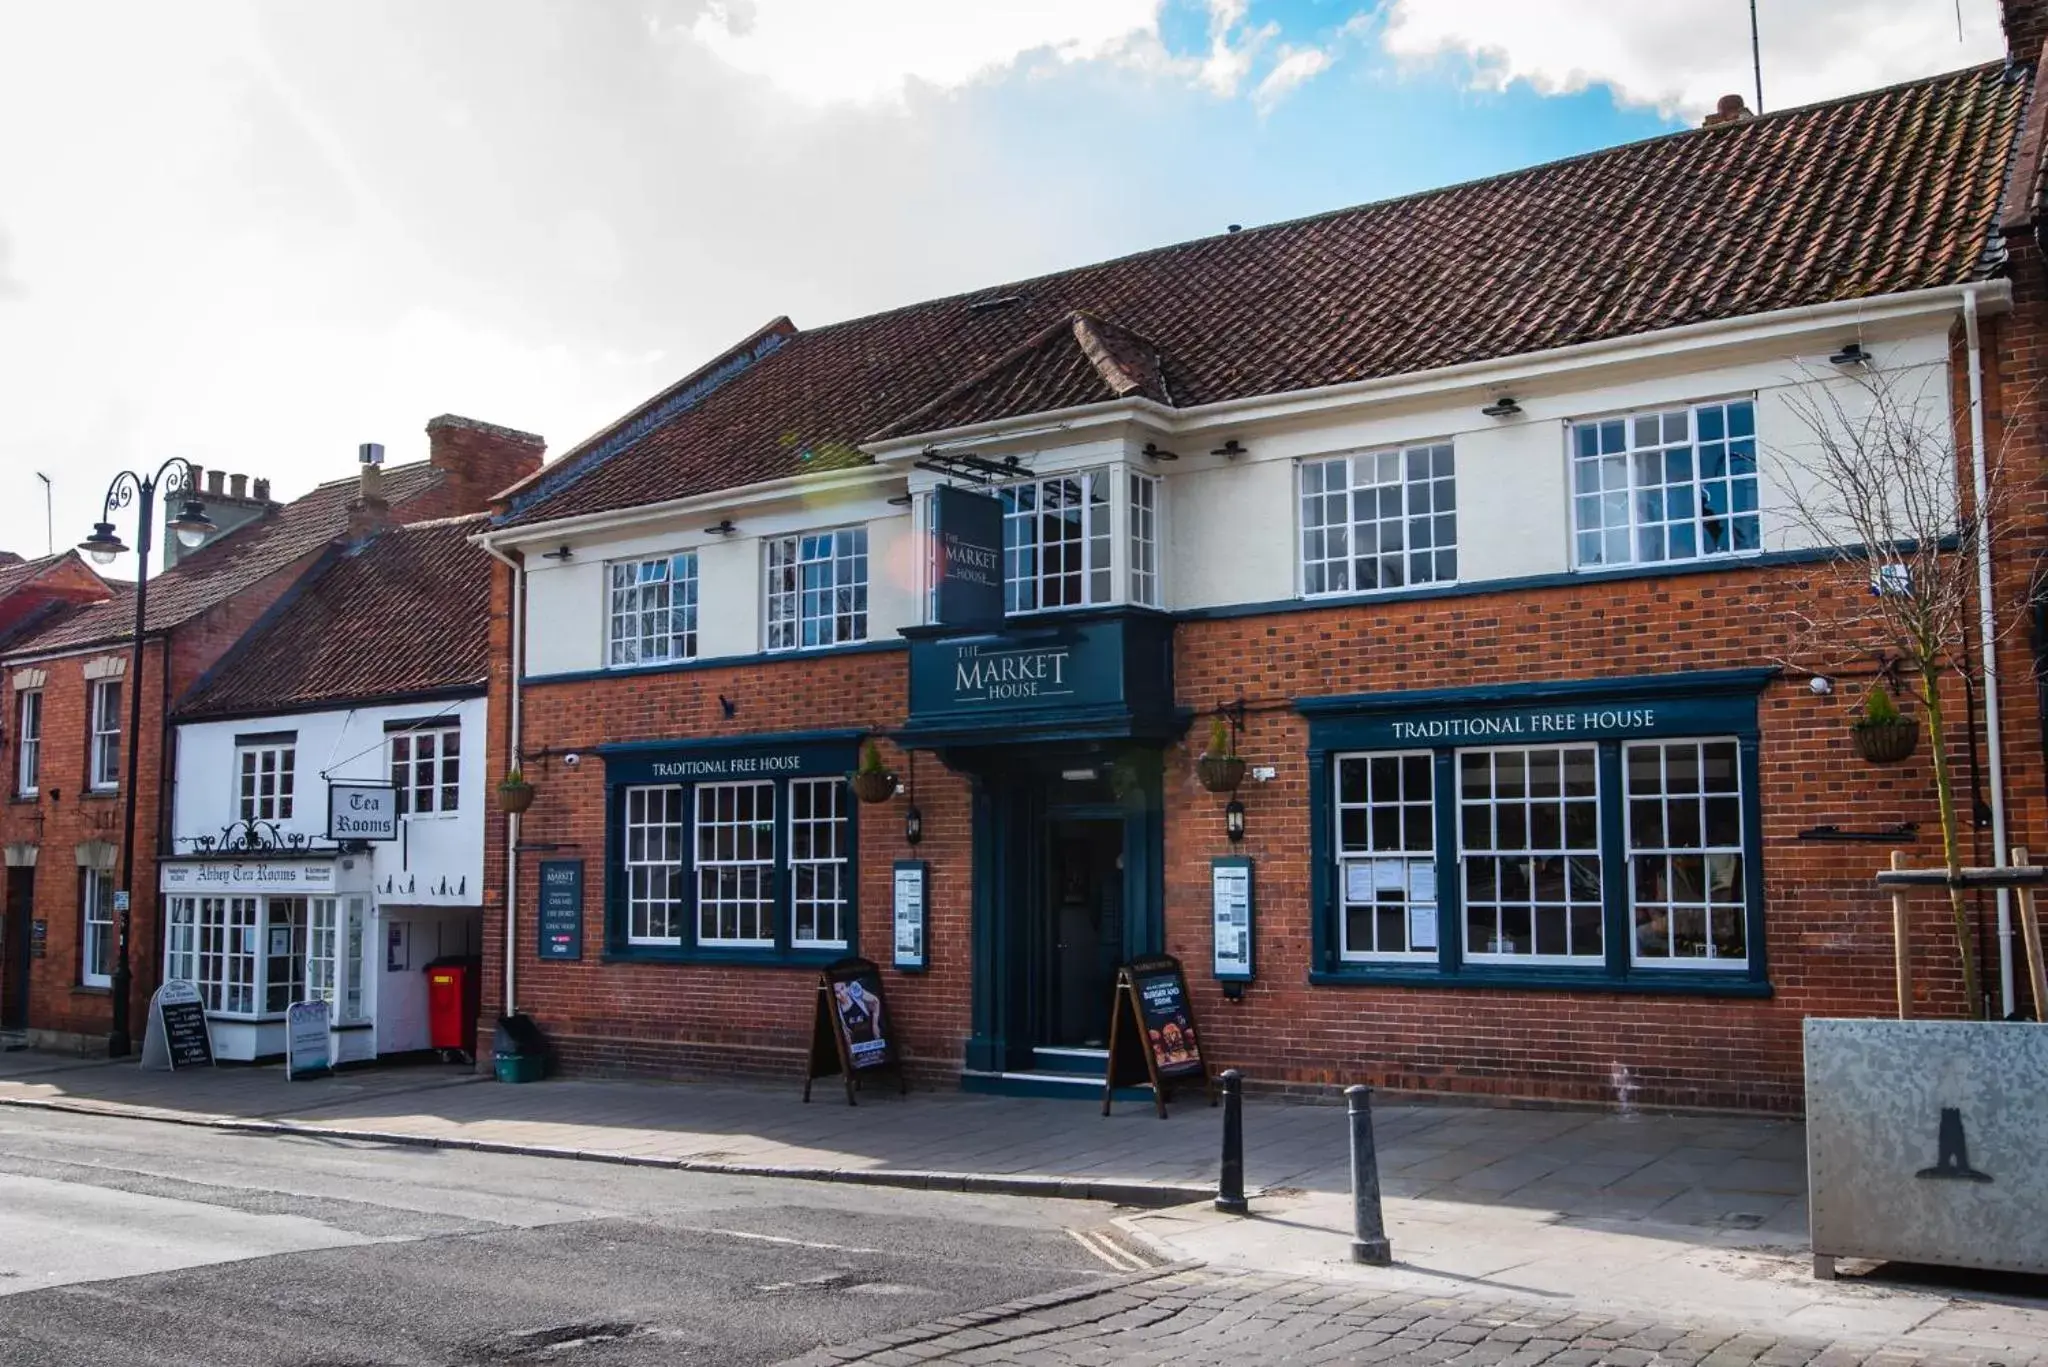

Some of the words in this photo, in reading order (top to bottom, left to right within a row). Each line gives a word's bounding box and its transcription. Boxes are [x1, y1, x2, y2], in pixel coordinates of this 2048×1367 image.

[945, 547, 997, 569] MARKET
[957, 568, 986, 583] HOUSE
[959, 646, 978, 657] THE
[955, 653, 1069, 691] MARKET
[989, 682, 1038, 699] HOUSE
[1392, 717, 1524, 738] TRADITIONAL
[1531, 714, 1576, 732] FREE
[1584, 710, 1655, 729] HOUSE
[652, 760, 727, 776] TRADITIONAL
[731, 758, 756, 772] FREE
[760, 756, 800, 770] HOUSE
[350, 794, 379, 811] Tea
[336, 815, 391, 832] Rooms
[197, 863, 230, 884] Abbey
[233, 863, 254, 881] Tea
[256, 863, 296, 882] Rooms
